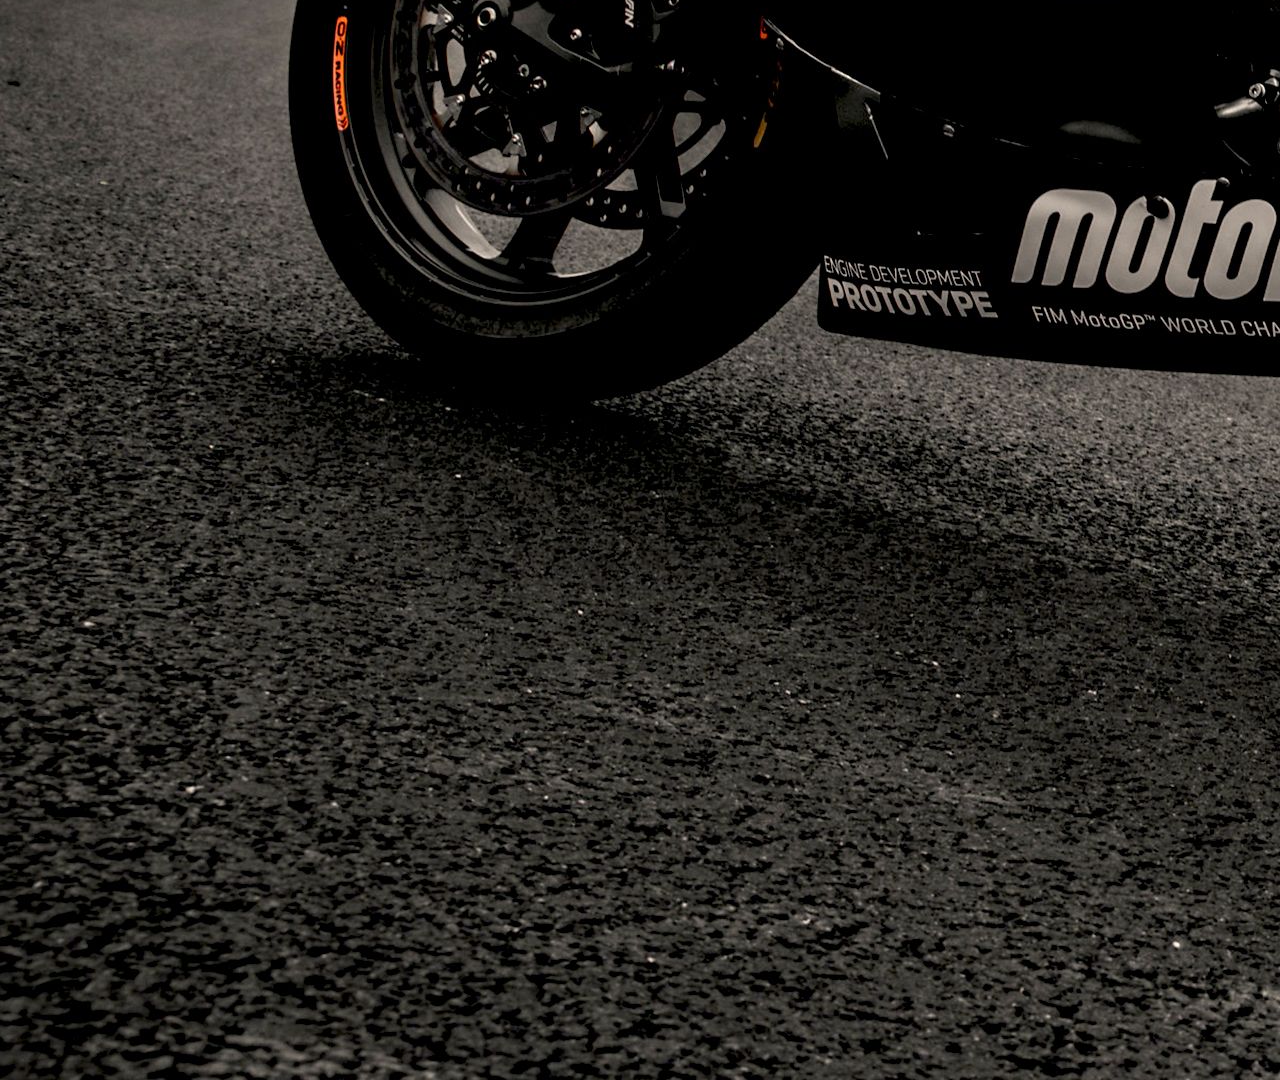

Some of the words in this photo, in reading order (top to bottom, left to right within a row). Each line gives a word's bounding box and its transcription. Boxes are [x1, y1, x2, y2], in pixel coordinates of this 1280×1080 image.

[335, 61, 344, 115] RACING
[823, 255, 868, 281] ENGINE
[869, 264, 983, 288] DEVELOPMENT
[827, 277, 999, 319] PROTOTYPE
[1031, 306, 1068, 325] FIM
[1160, 316, 1237, 336] WORLD
